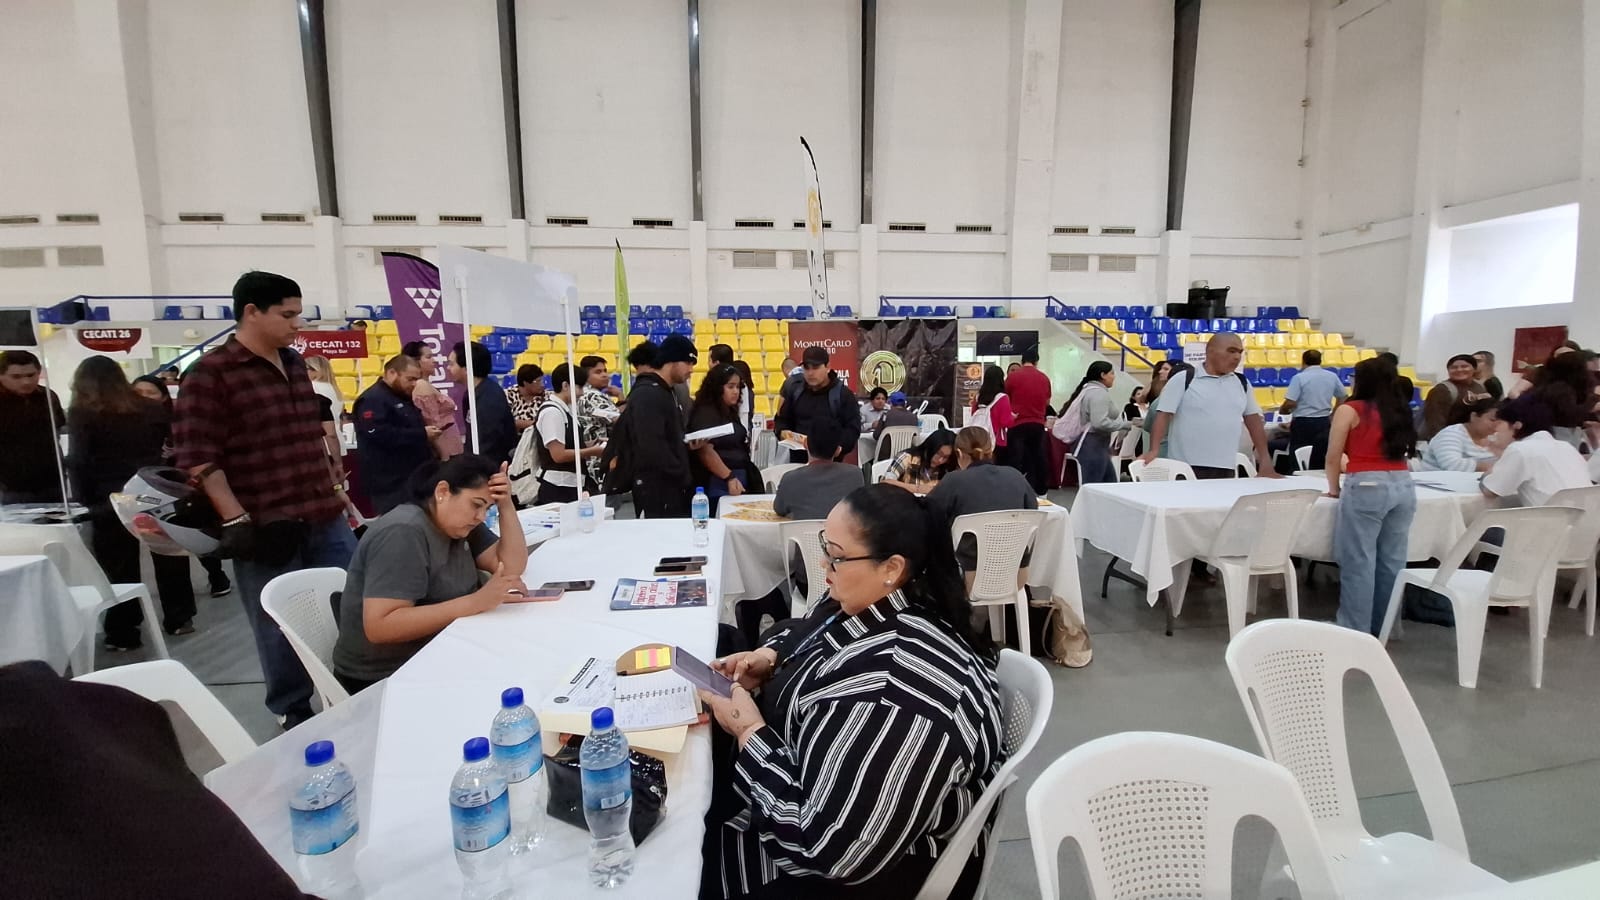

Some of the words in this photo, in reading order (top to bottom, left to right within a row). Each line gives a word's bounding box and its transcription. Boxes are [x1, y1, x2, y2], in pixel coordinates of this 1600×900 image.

[83, 330, 117, 339] CECATI
[118, 330, 131, 338] 26
[309, 341, 343, 349] CECATI
[346, 340, 361, 348] 132
